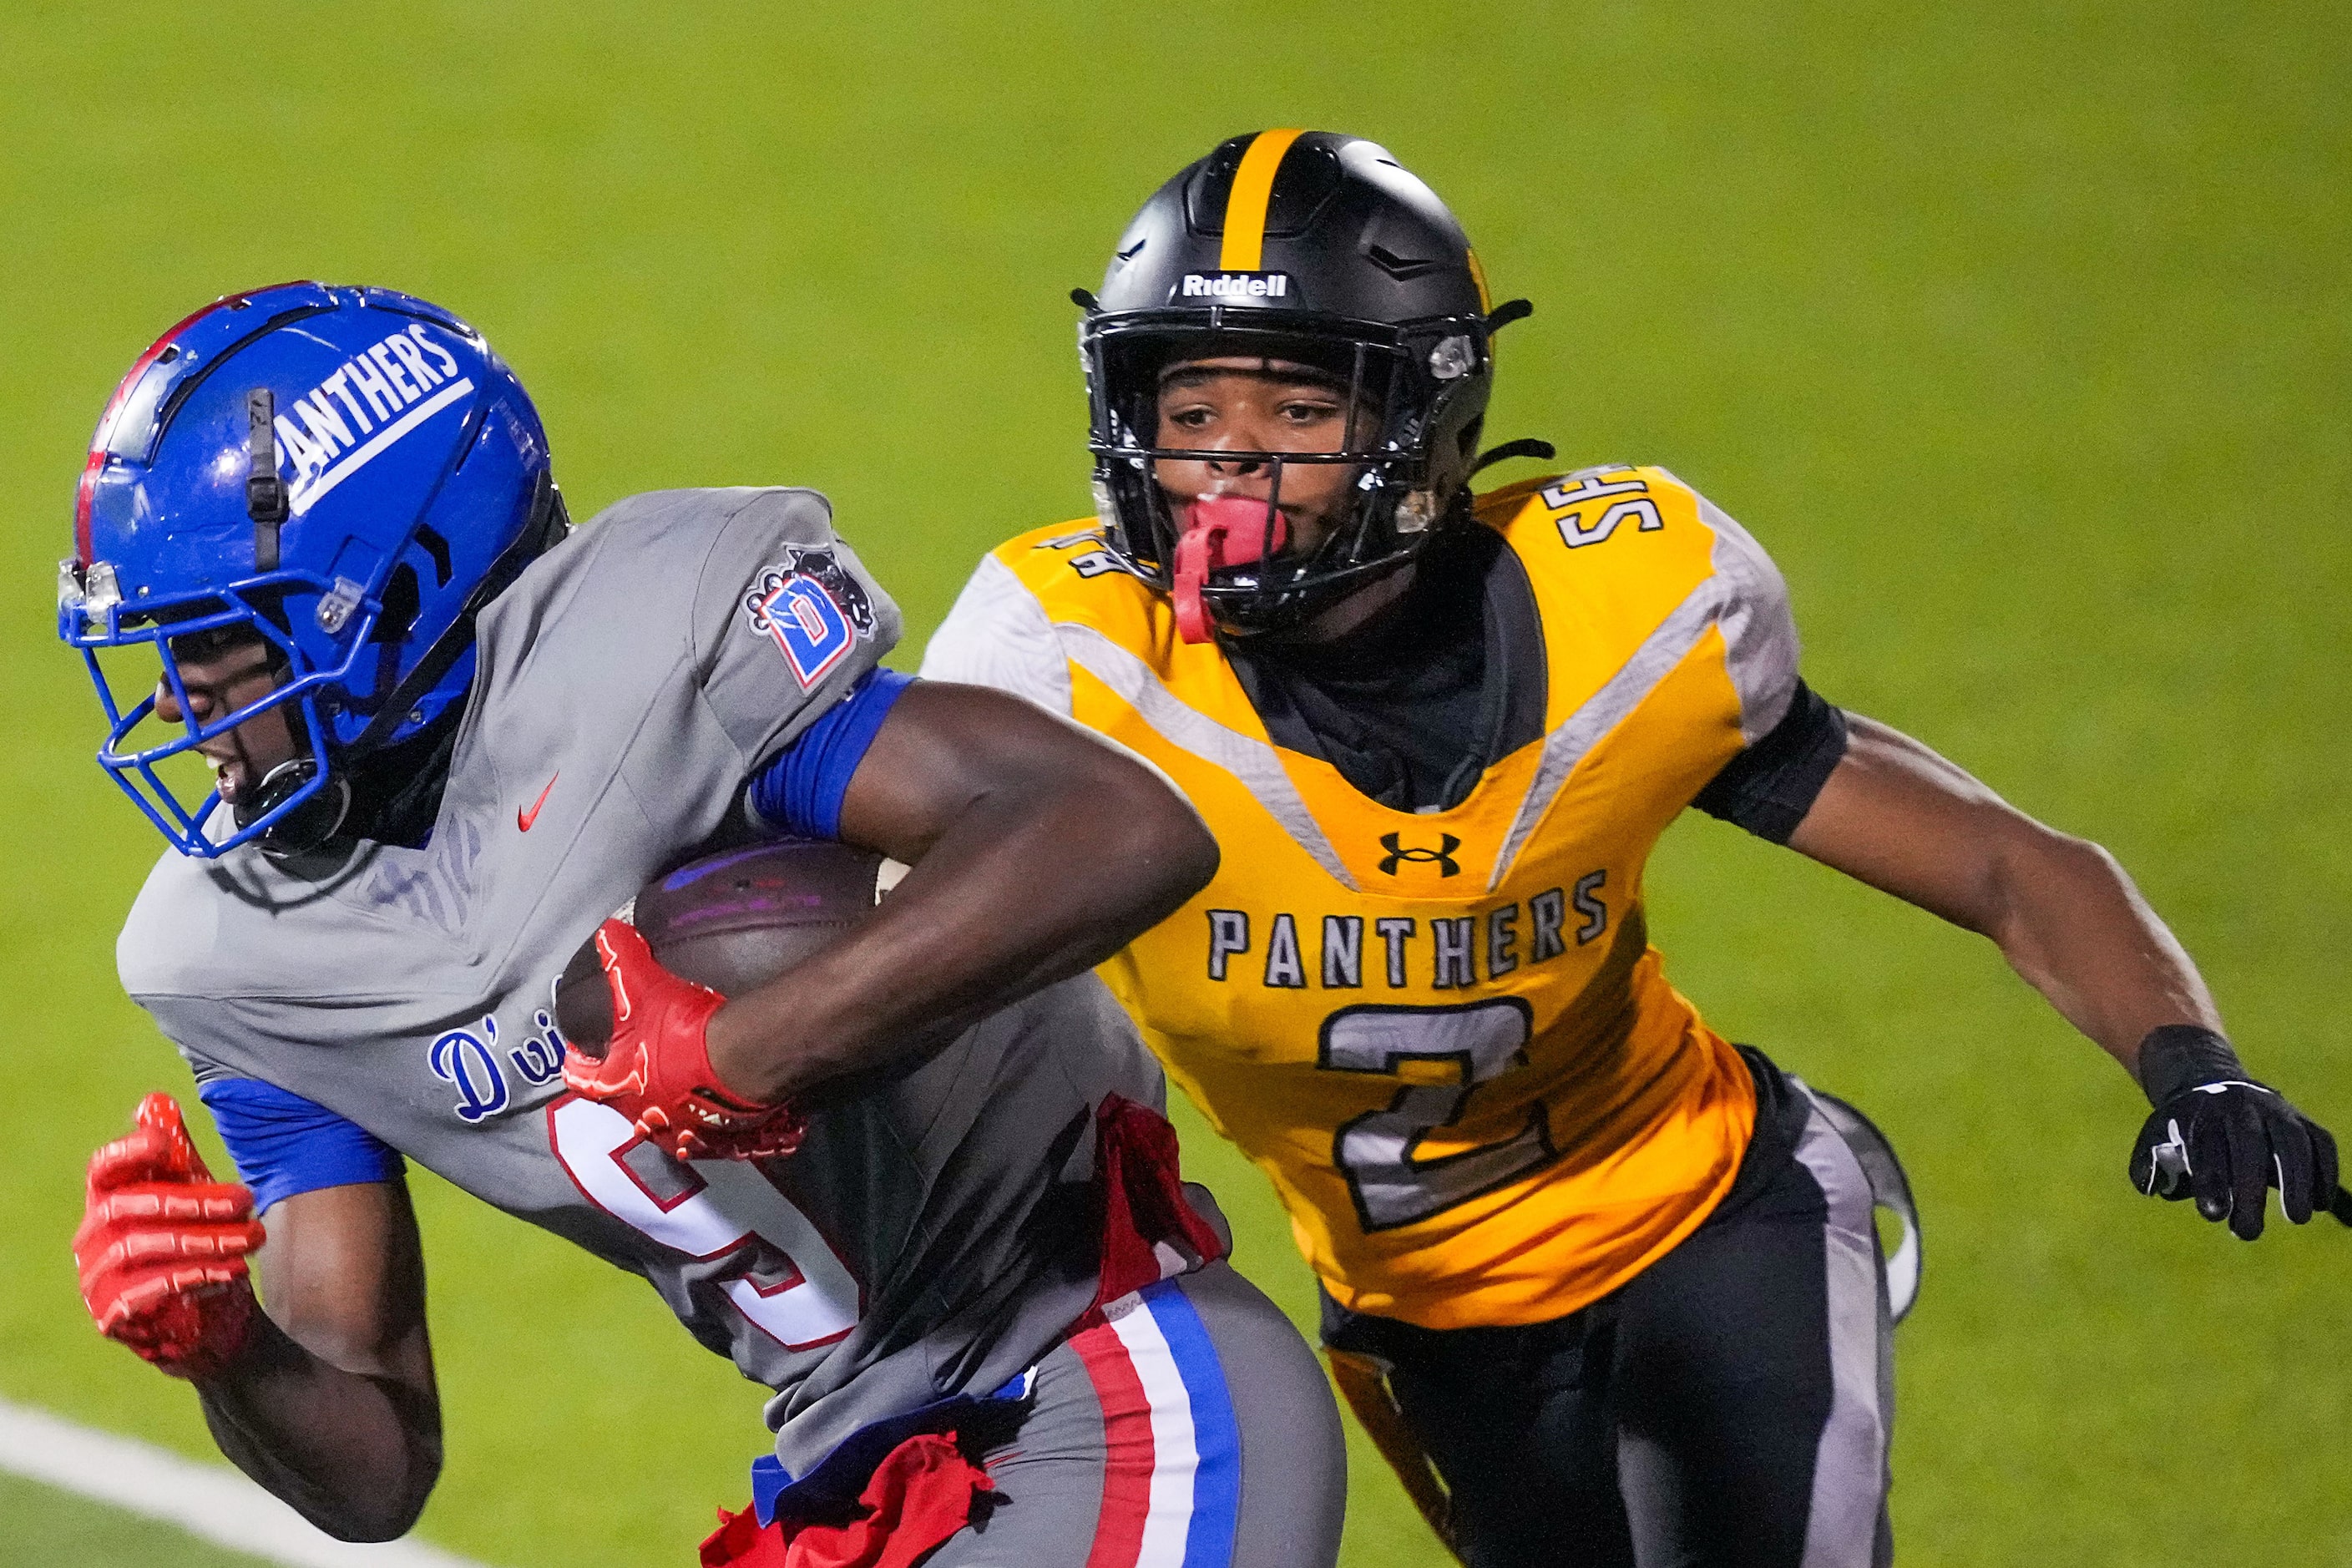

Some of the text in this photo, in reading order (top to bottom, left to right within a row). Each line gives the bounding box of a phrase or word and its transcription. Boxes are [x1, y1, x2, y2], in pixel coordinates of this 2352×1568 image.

[1182, 274, 1287, 296] Riddell
[1207, 869, 1608, 989] PANTHERS
[1317, 995, 1559, 1234] 2
